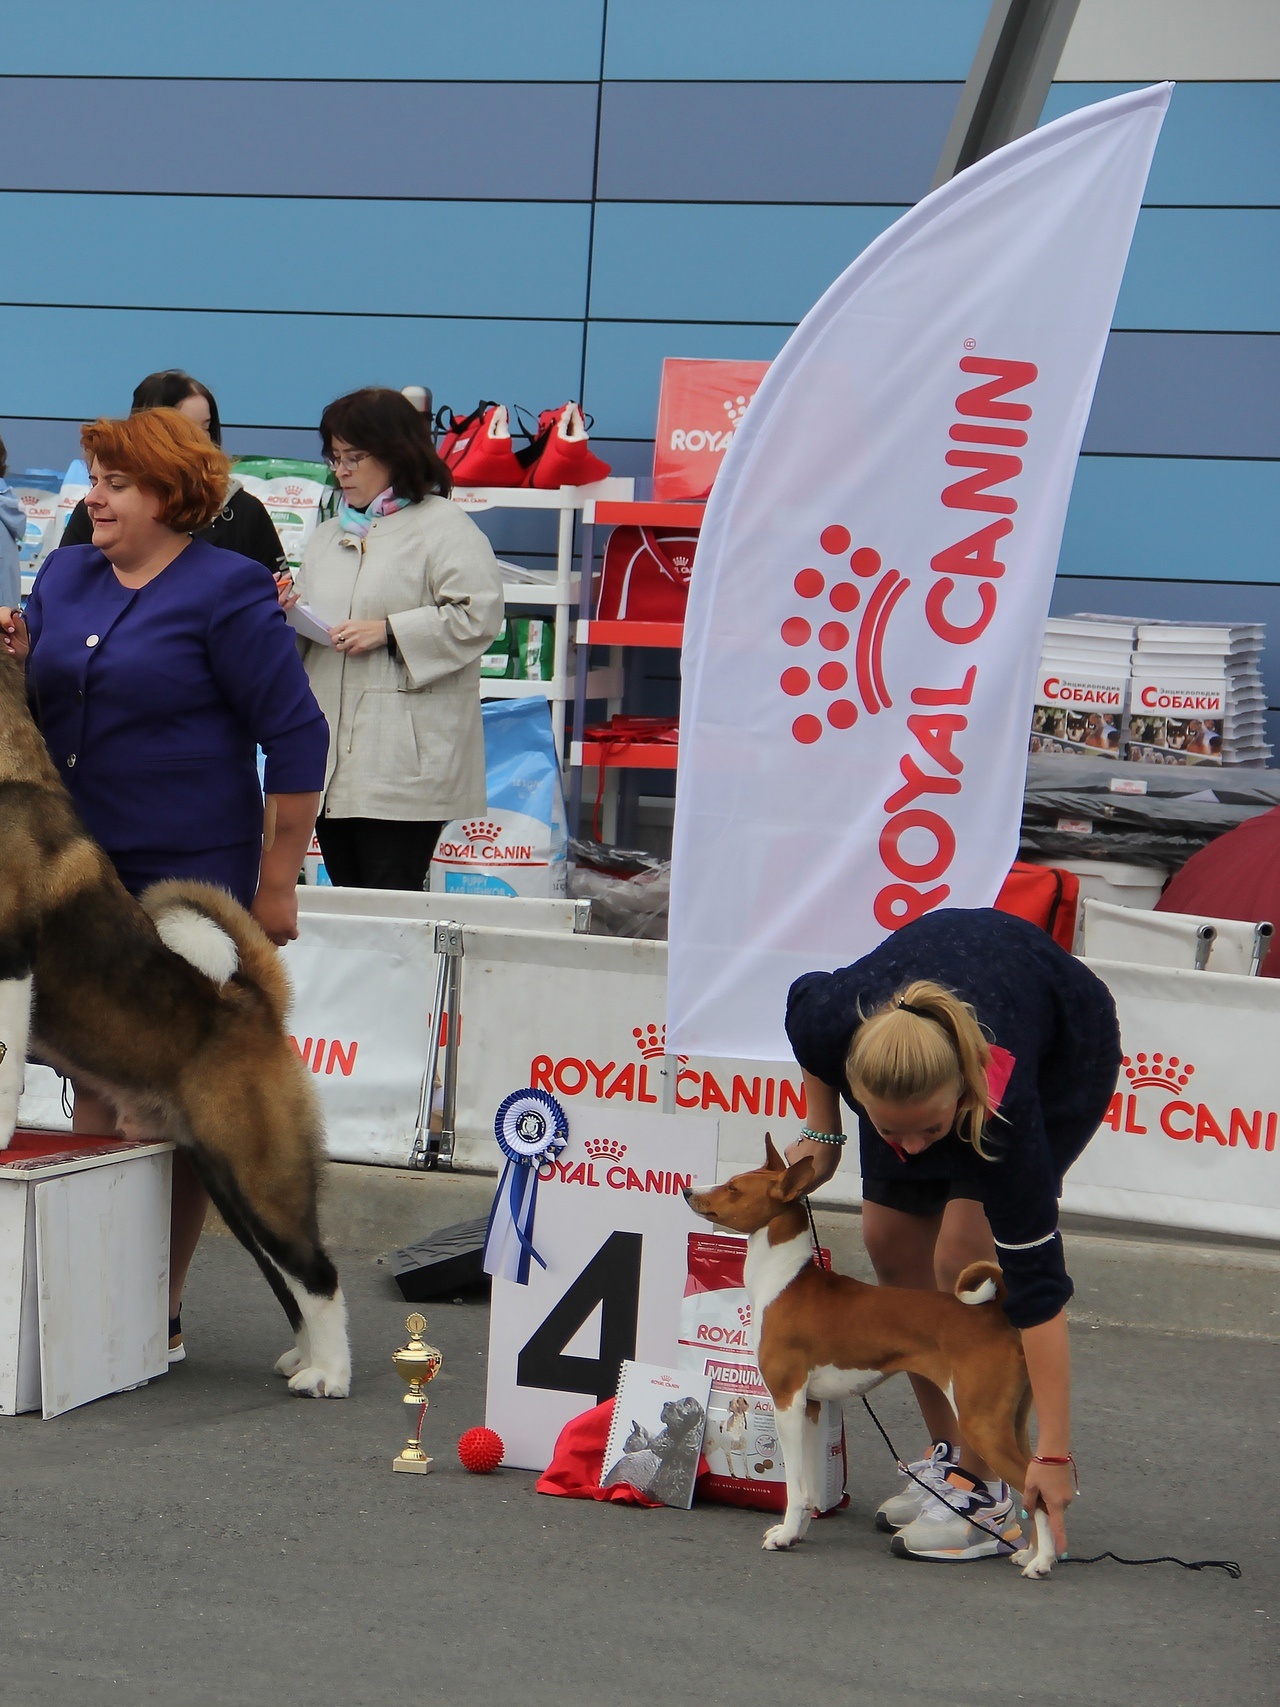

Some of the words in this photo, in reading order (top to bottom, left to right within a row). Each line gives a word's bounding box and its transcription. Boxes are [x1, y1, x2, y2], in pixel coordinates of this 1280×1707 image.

[671, 428, 734, 452] ROYA
[924, 354, 1039, 645] CANIN
[271, 512, 290, 521] MINI
[439, 842, 478, 859] ROYAL
[481, 845, 531, 860] CANIN
[531, 1055, 657, 1104] ROYAL
[675, 1069, 807, 1120] CANIN
[1160, 1101, 1278, 1152] CANI
[538, 1160, 600, 1188] OYAL
[606, 1165, 691, 1195] CANIN
[517, 1231, 643, 1407] 4
[697, 1324, 748, 1347] ROYAL
[707, 1365, 766, 1386] MEDIUM
[754, 1401, 774, 1411] Adu
